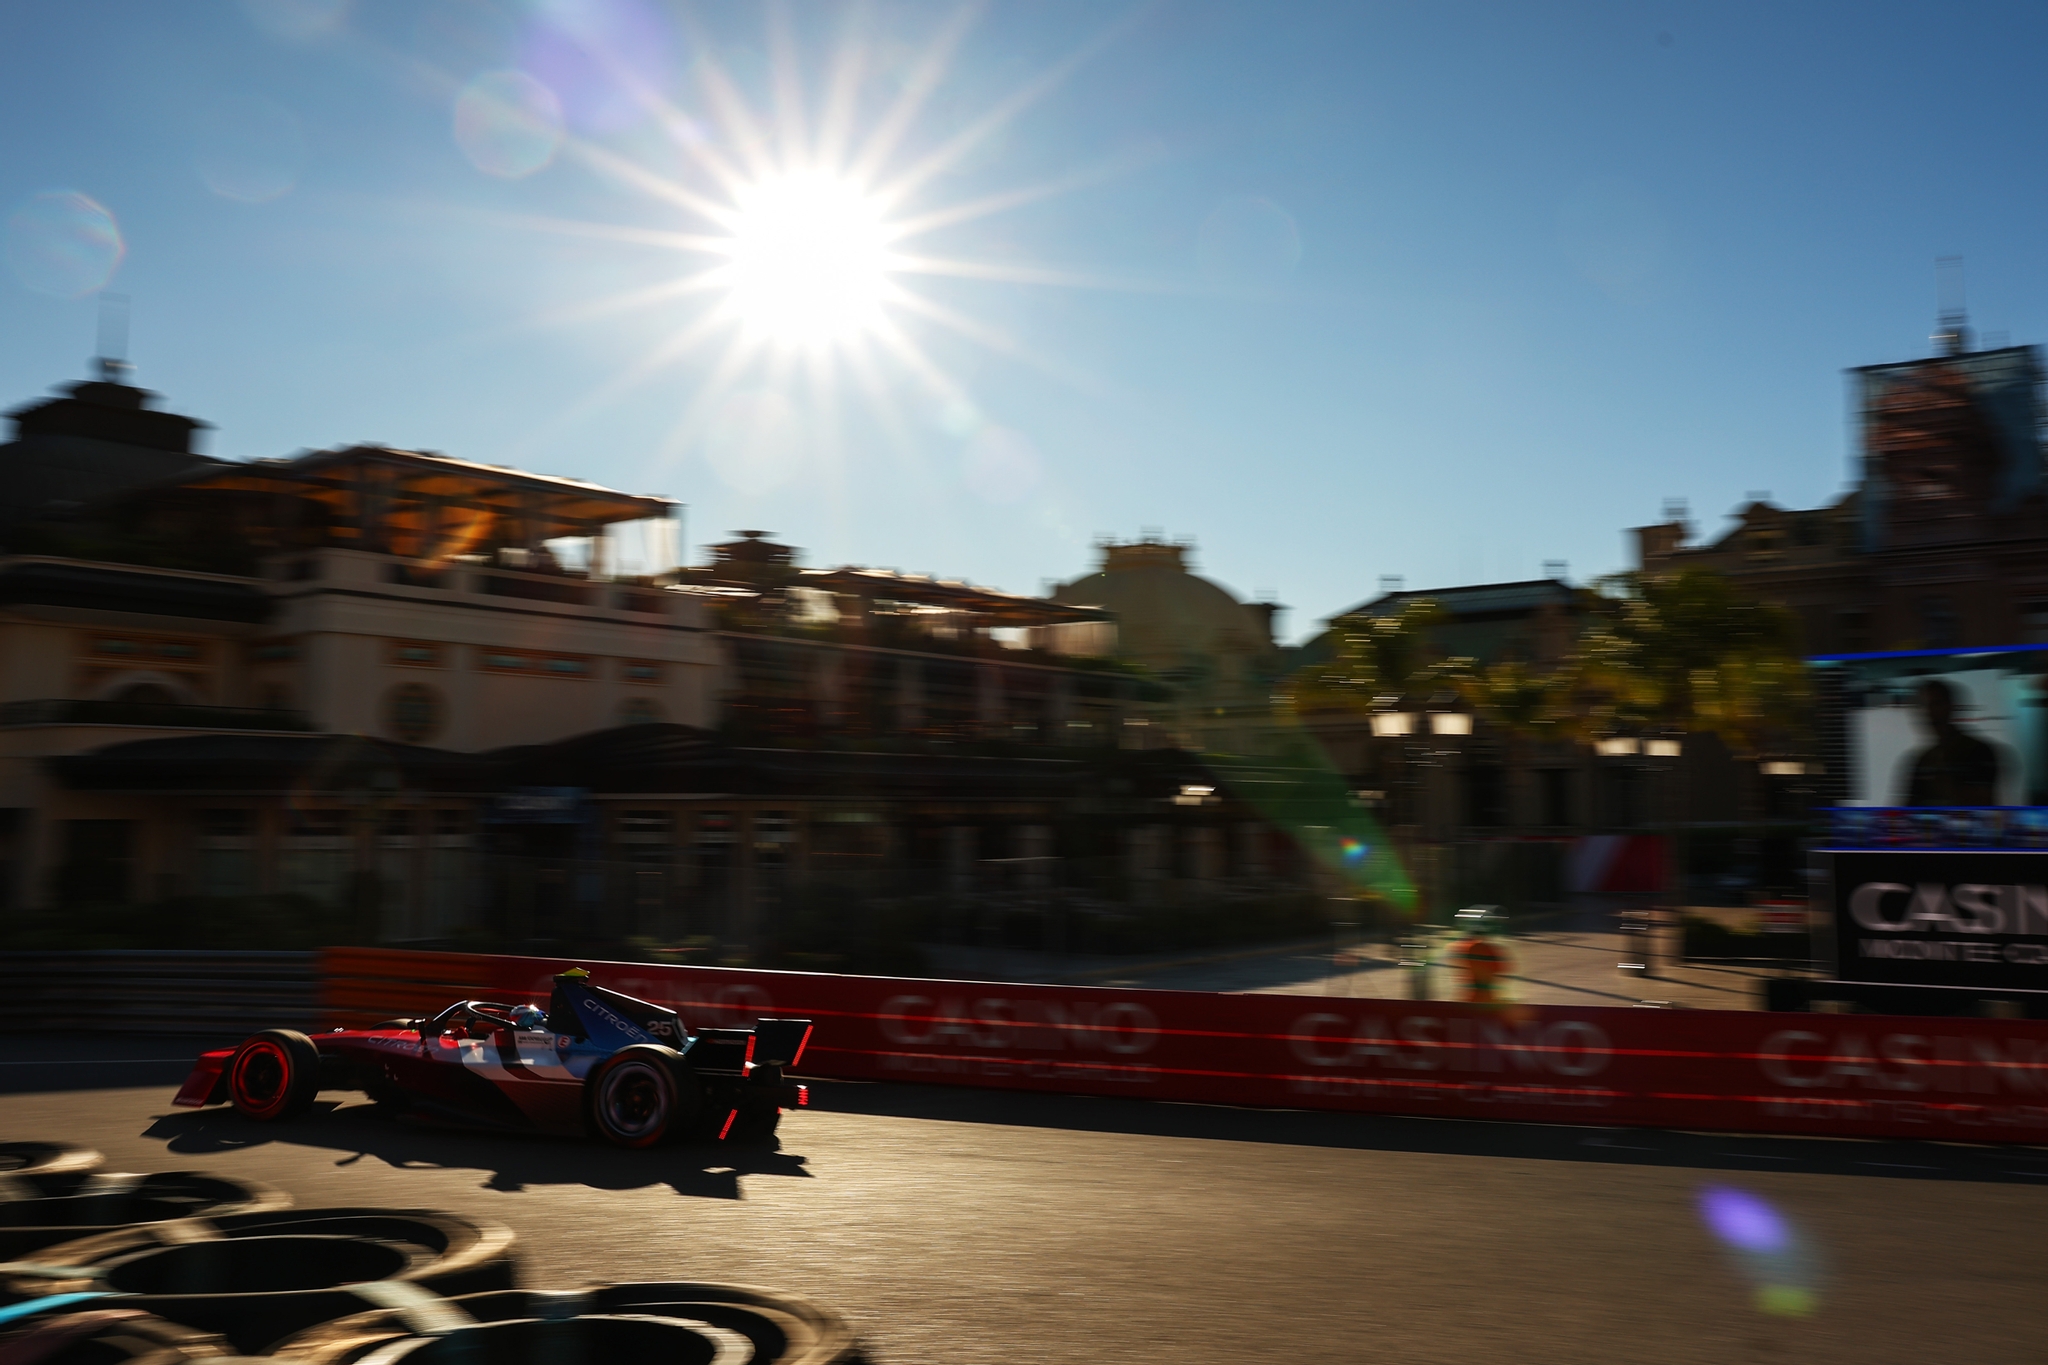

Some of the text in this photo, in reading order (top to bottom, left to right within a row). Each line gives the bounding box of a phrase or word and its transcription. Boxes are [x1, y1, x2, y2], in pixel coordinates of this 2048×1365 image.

[646, 1020, 673, 1037] 25
[873, 993, 1161, 1054] CASINO
[1287, 1011, 1614, 1076] CASINO
